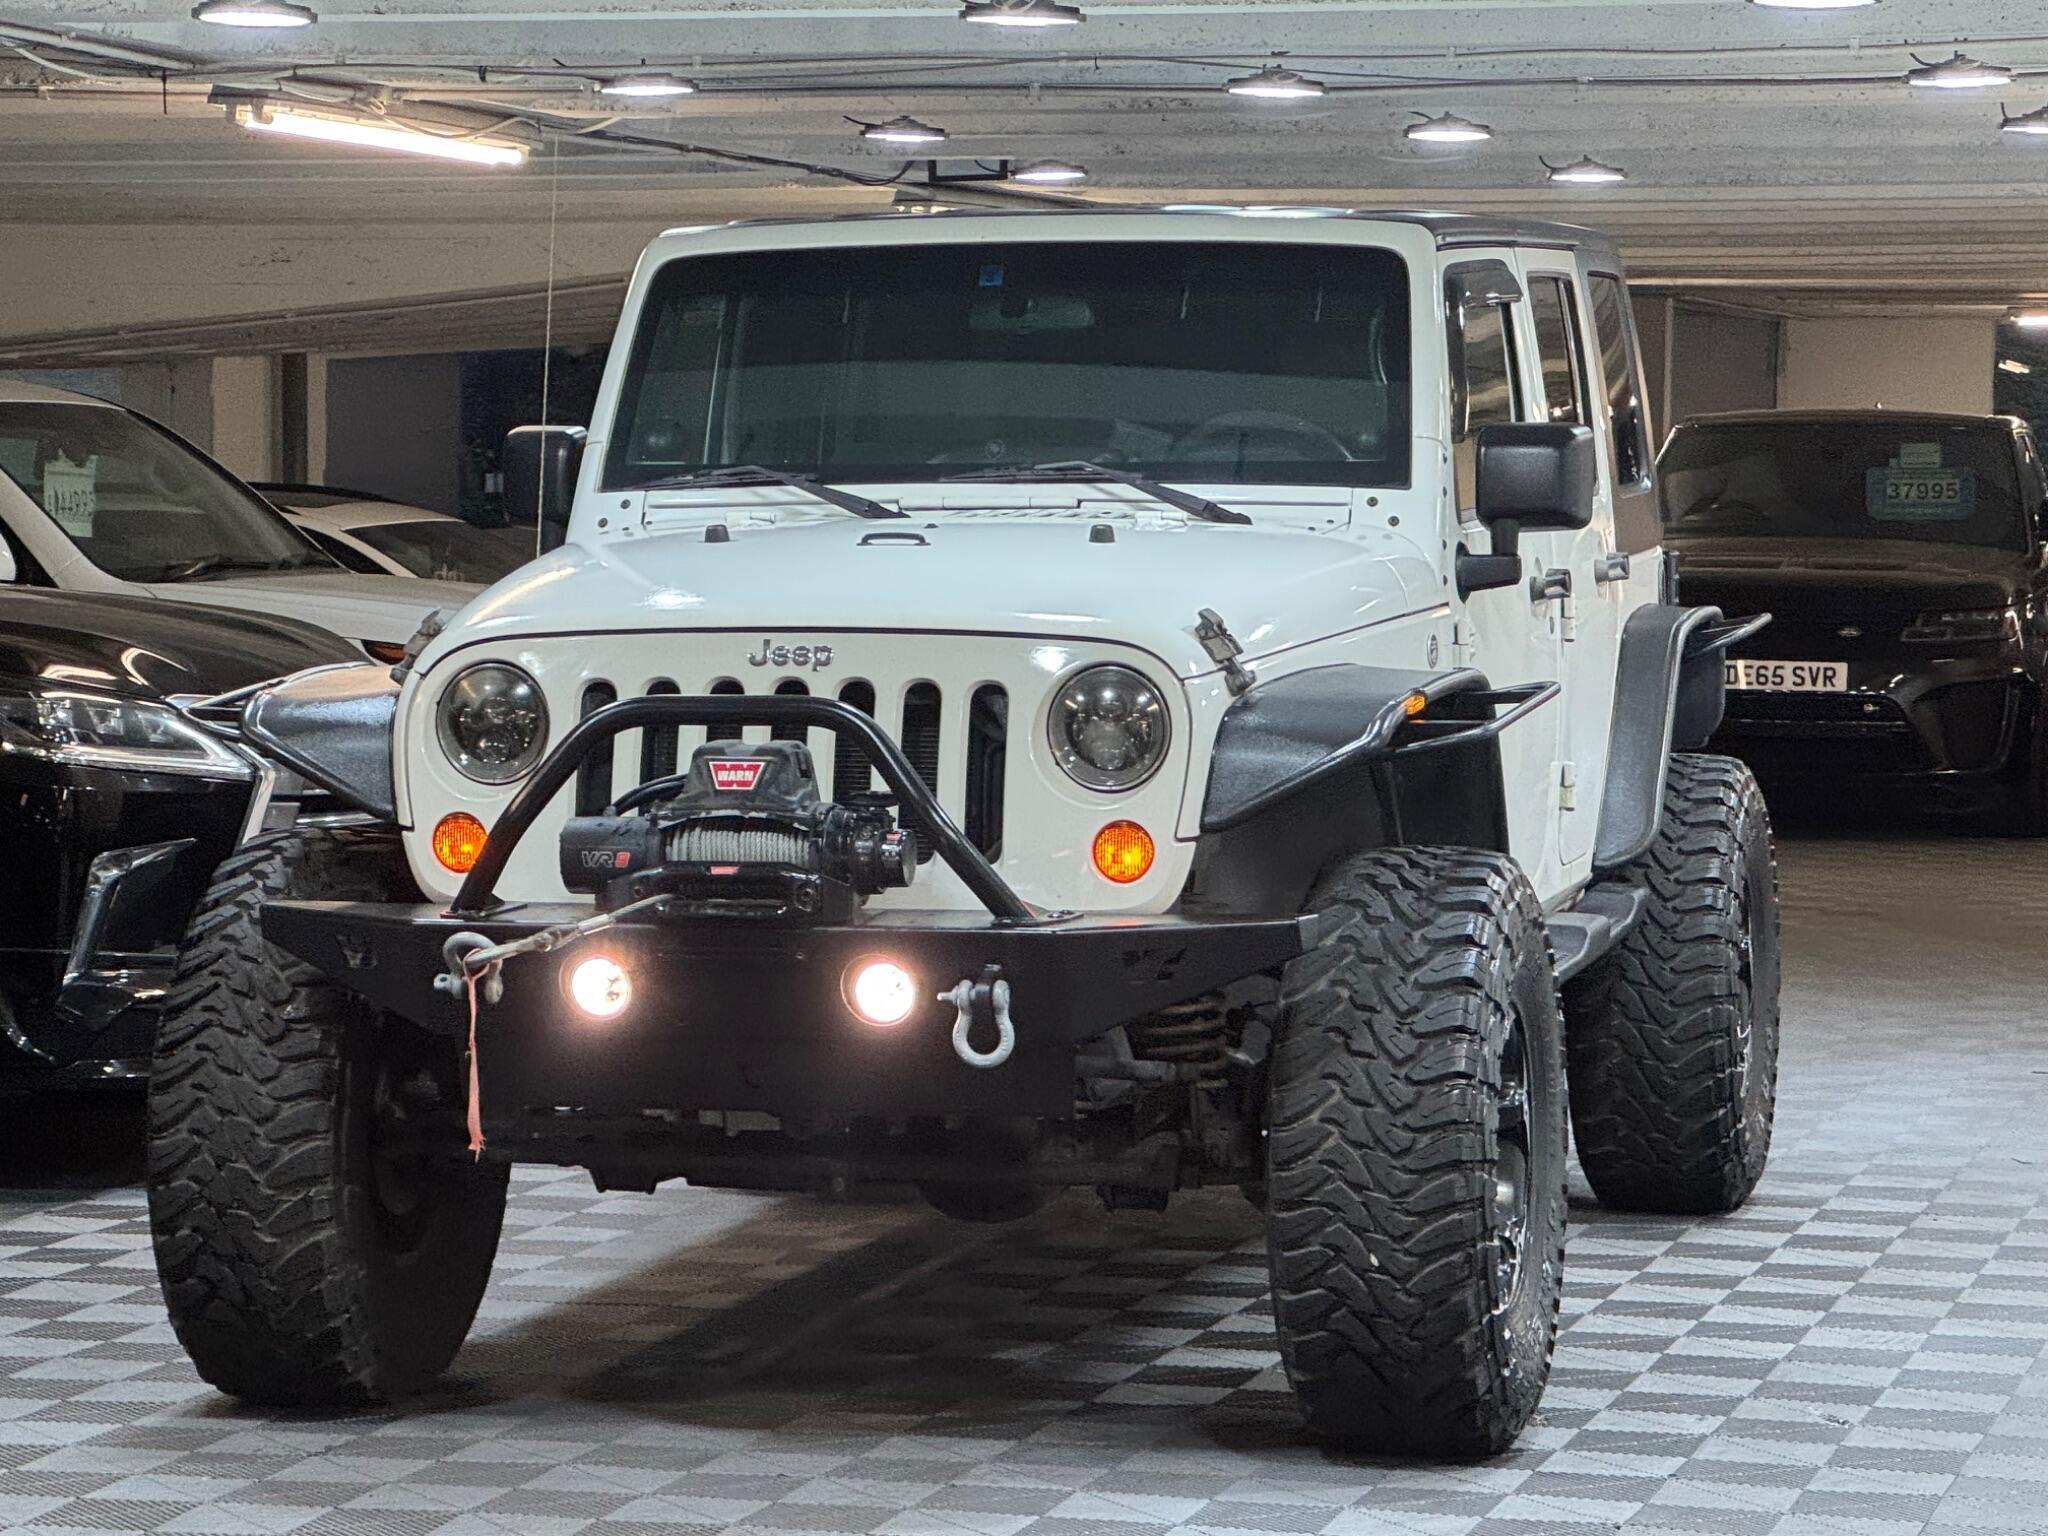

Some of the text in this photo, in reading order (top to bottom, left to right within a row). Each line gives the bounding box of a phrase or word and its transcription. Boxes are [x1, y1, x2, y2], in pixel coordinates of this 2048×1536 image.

[1887, 482, 1959, 500] 37995
[746, 639, 835, 672] Jeep
[1725, 664, 1837, 688] DE65 SVR
[717, 770, 754, 782] WARN
